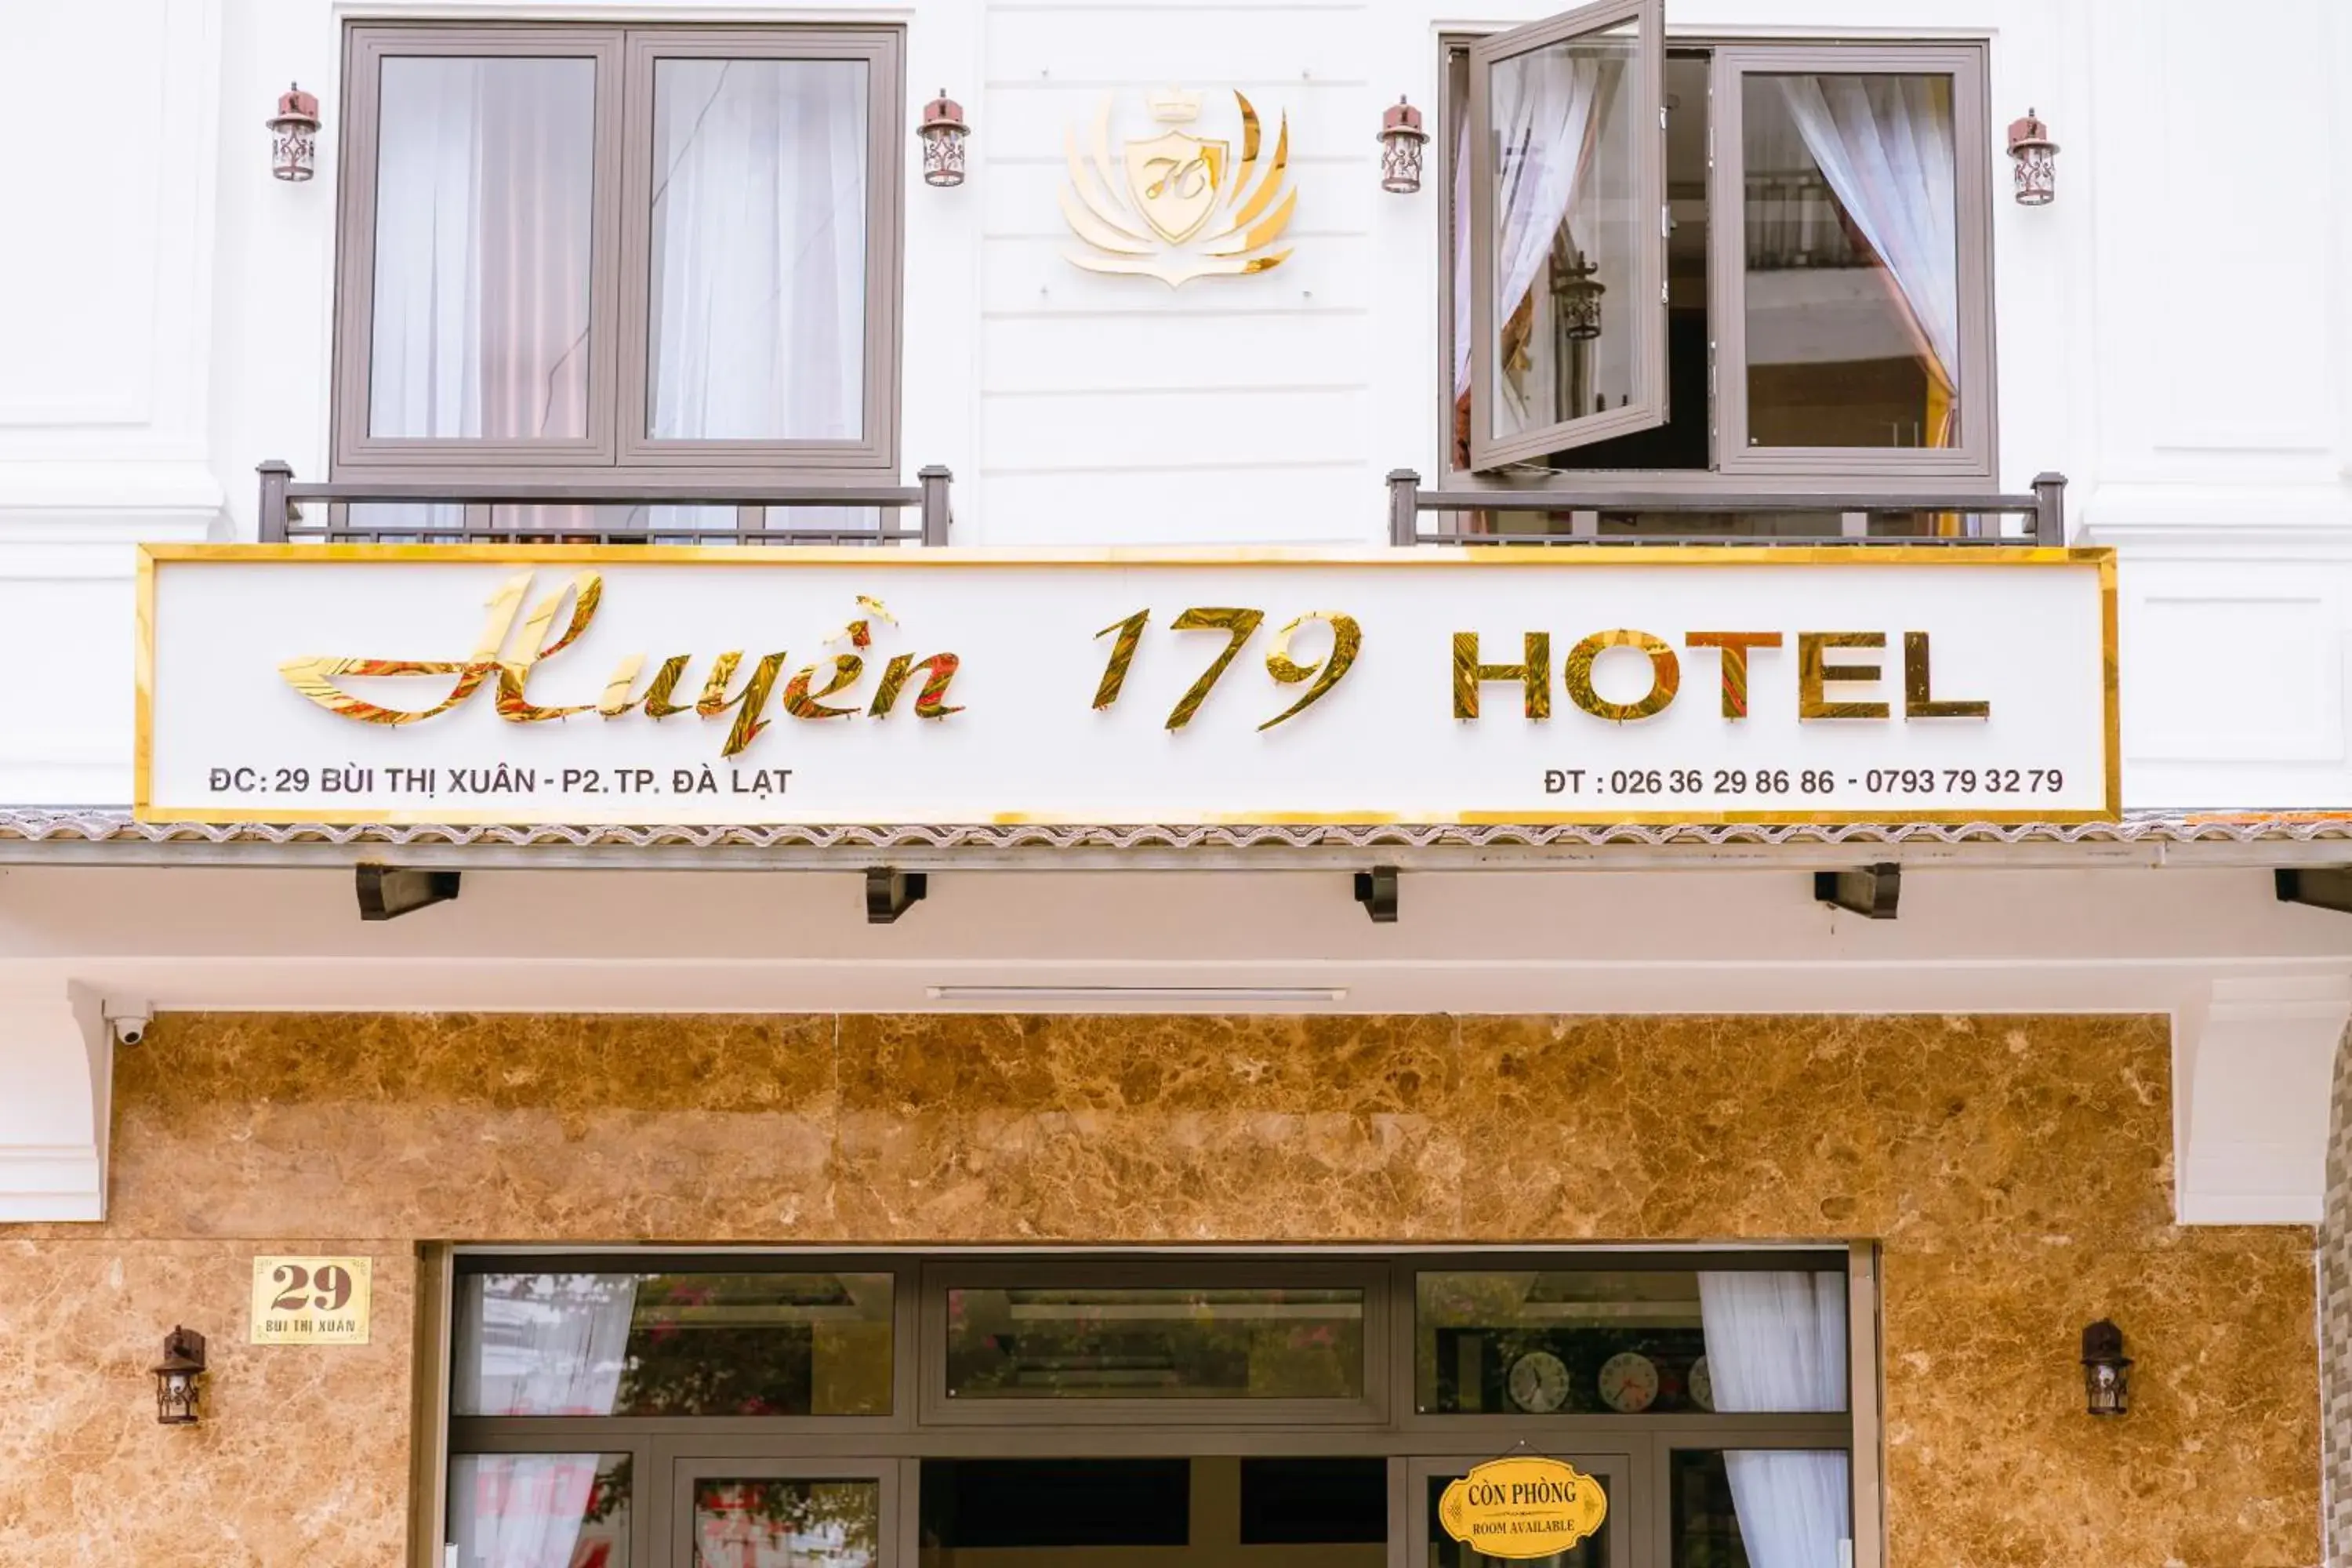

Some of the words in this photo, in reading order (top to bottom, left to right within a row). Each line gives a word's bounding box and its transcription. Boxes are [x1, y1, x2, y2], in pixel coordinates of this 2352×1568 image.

[278, 568, 966, 757] Huyền
[1091, 606, 1363, 732] 179
[1452, 630, 1990, 720] HOTEL
[275, 768, 310, 793] 29
[321, 762, 373, 793] BÙI
[384, 768, 436, 799] THỊ
[448, 762, 535, 794] XUÂN
[672, 763, 718, 793] ĐÀ
[731, 768, 793, 800] LẠT
[1865, 769, 1935, 793] 0793
[270, 1265, 351, 1312] 29
[1468, 1479, 1506, 1506] CÒN
[1512, 1476, 1576, 1504] PHÒNG
[1473, 1523, 1506, 1535] ROOM
[1510, 1519, 1575, 1534] AVAILABLE
